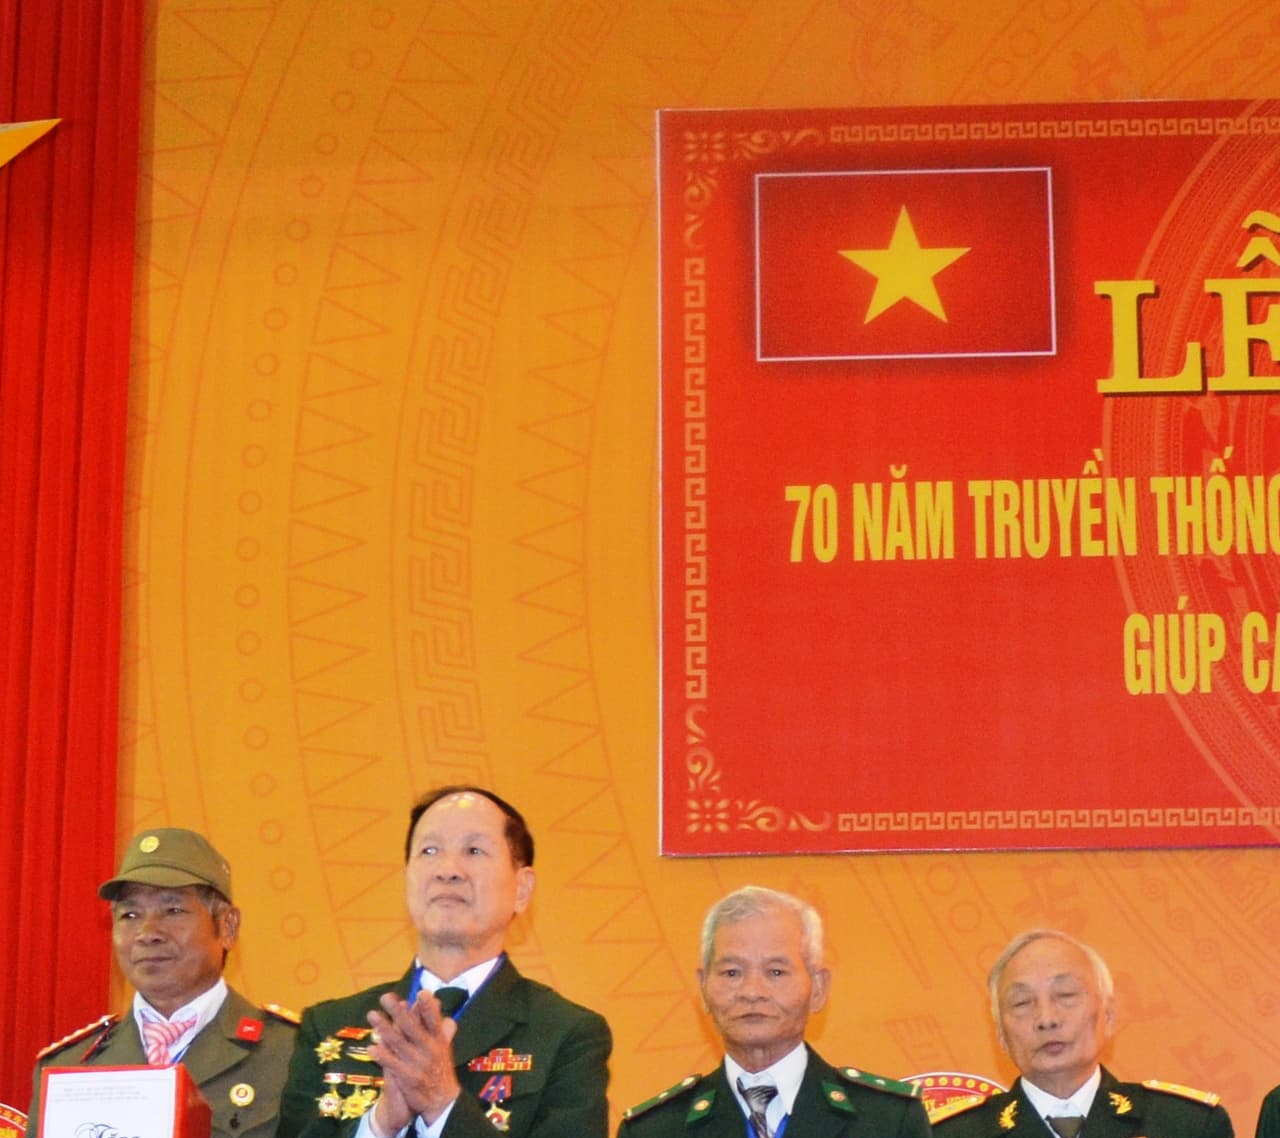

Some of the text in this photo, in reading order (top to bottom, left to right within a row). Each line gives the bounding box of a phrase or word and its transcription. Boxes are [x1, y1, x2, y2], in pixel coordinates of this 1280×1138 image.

[785, 483, 838, 563] 70
[853, 464, 954, 561] NĂM
[967, 448, 1138, 559] TRUYỀN
[1123, 595, 1226, 696] GIÚP
